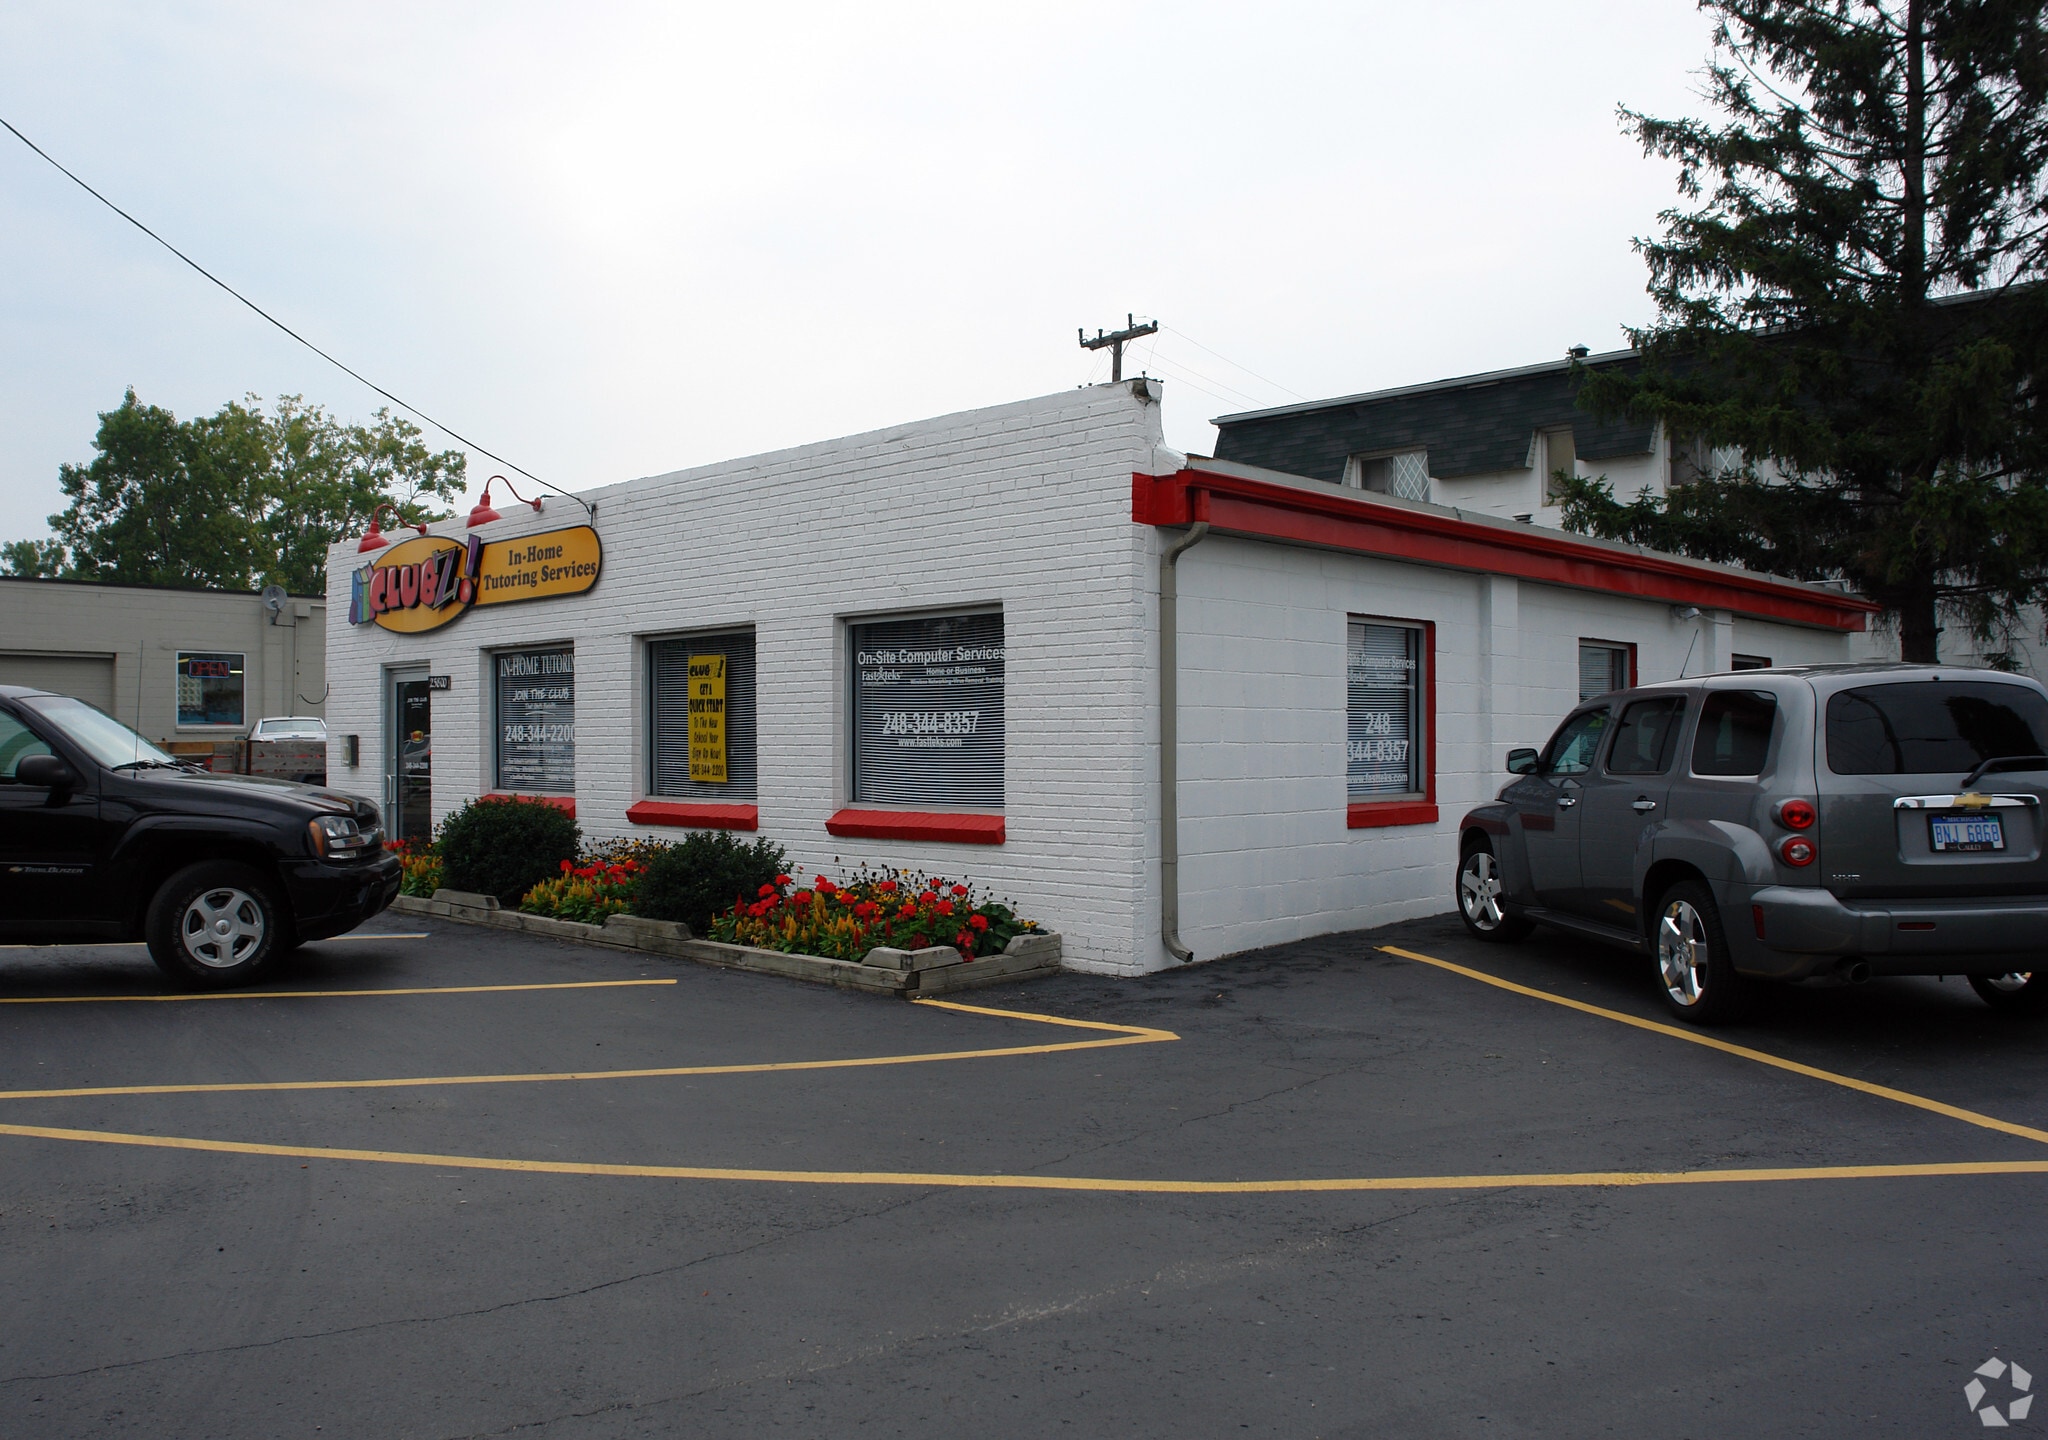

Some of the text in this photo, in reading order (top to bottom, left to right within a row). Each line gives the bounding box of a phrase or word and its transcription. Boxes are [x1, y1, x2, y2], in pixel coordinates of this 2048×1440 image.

[508, 545, 563, 566] In-Home
[484, 560, 597, 591] Tutoring Services
[858, 645, 1005, 666] On-Site Computer Services
[191, 662, 228, 677] OPEN
[500, 656, 540, 677] IN-HOME
[954, 665, 986, 674] Business
[706, 699, 723, 713] START
[882, 711, 979, 735] 248-344-8357
[1365, 712, 1390, 734] 248
[1934, 824, 2000, 844] BNJ 6868
